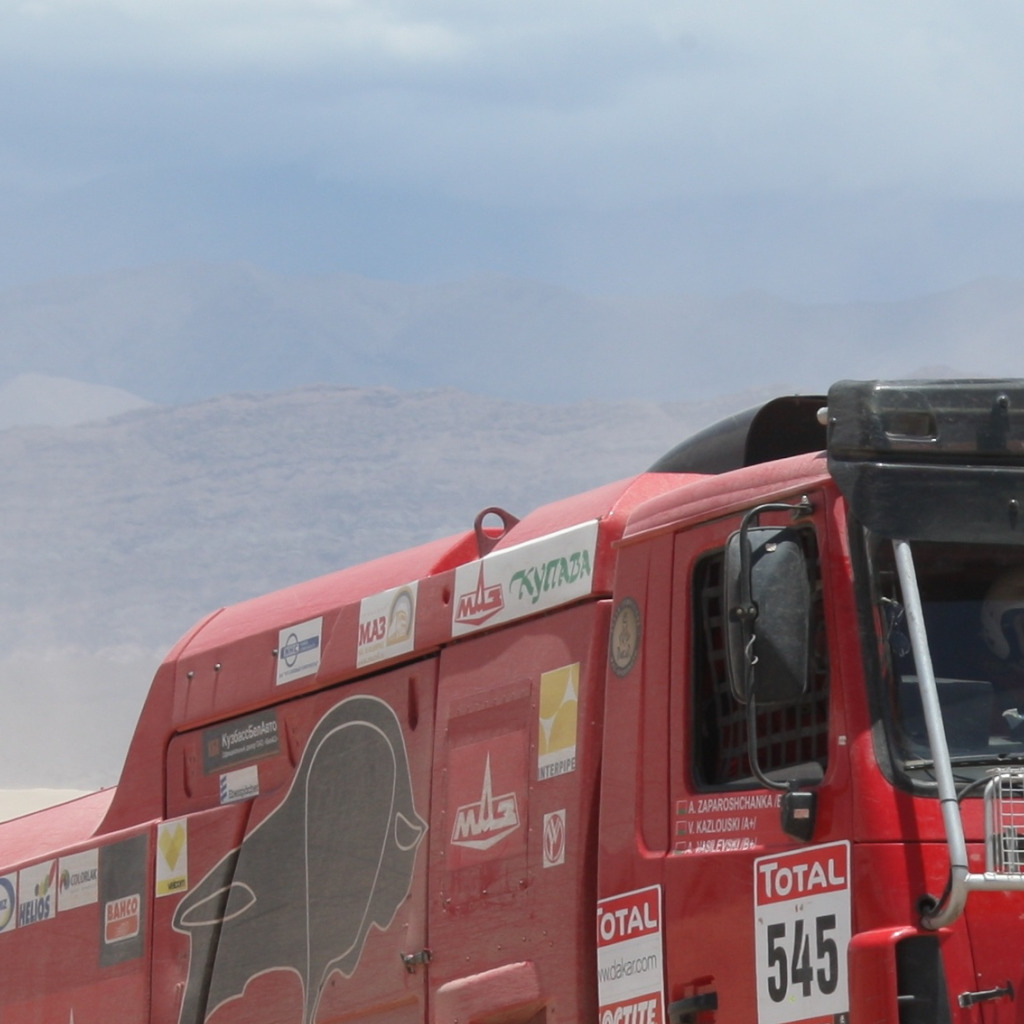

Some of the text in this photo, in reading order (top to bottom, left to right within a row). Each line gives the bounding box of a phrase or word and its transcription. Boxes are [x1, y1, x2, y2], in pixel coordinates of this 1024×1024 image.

[508, 549, 591, 604] КУПАВА
[359, 616, 387, 646] МАЗ
[688, 802, 696, 814] A.
[698, 794, 772, 812] ZAPAROSHCHANKA
[688, 821, 695, 835] V.
[696, 817, 741, 834] KAZLOUSKI
[760, 858, 845, 897] TOTAL
[19, 895, 51, 926] HELIOS
[106, 898, 138, 923] BAHCO
[766, 914, 838, 1003] 545
